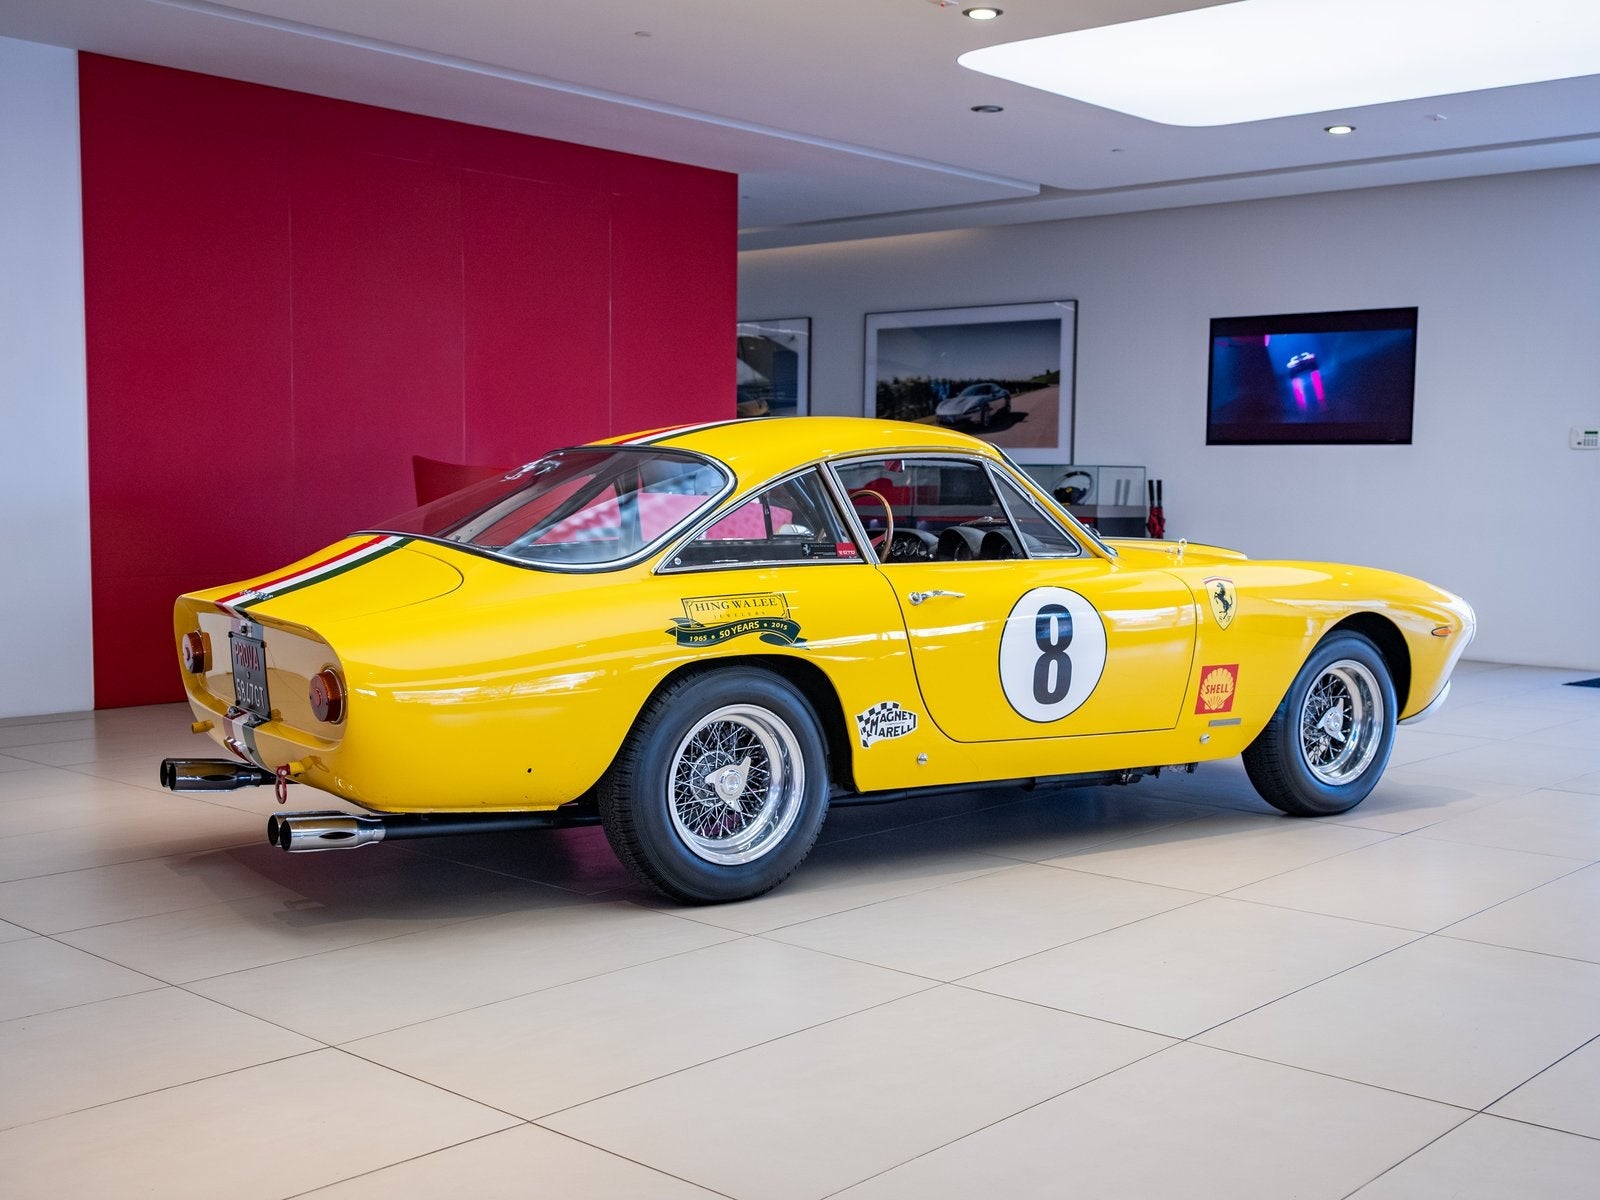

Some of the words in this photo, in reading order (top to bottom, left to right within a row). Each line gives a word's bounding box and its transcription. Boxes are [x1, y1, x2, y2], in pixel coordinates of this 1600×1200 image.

[695, 601, 730, 611] HING
[731, 599, 751, 609] WA
[753, 598, 778, 607] LEE
[719, 629, 731, 639] 50
[731, 620, 760, 635] YEARS
[1032, 603, 1073, 705] 8
[1205, 683, 1229, 695] SHELL
